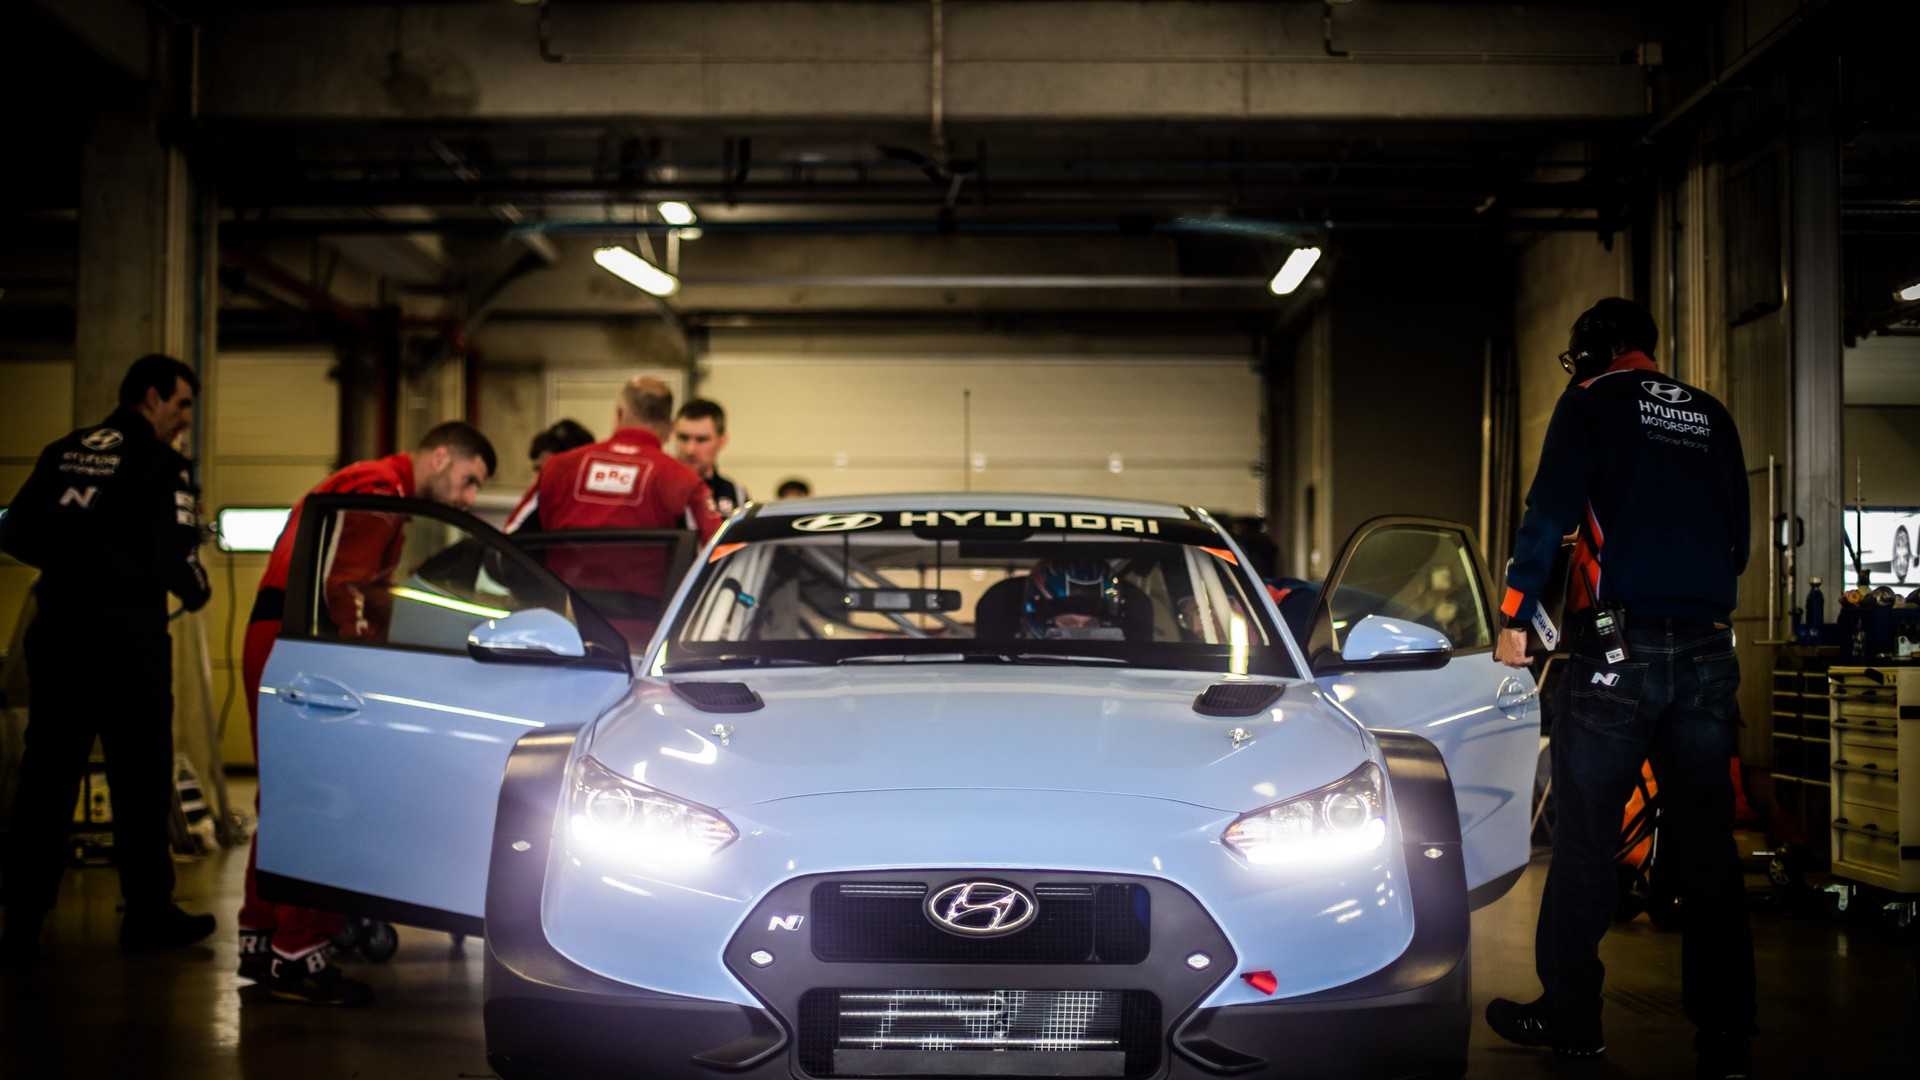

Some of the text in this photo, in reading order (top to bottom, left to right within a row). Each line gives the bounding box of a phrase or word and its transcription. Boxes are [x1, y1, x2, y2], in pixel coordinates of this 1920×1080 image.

[1638, 399, 1709, 426] HYUNDAI
[1640, 414, 1712, 438] MOTORSPORT
[899, 510, 1160, 536] HYUNDAI
